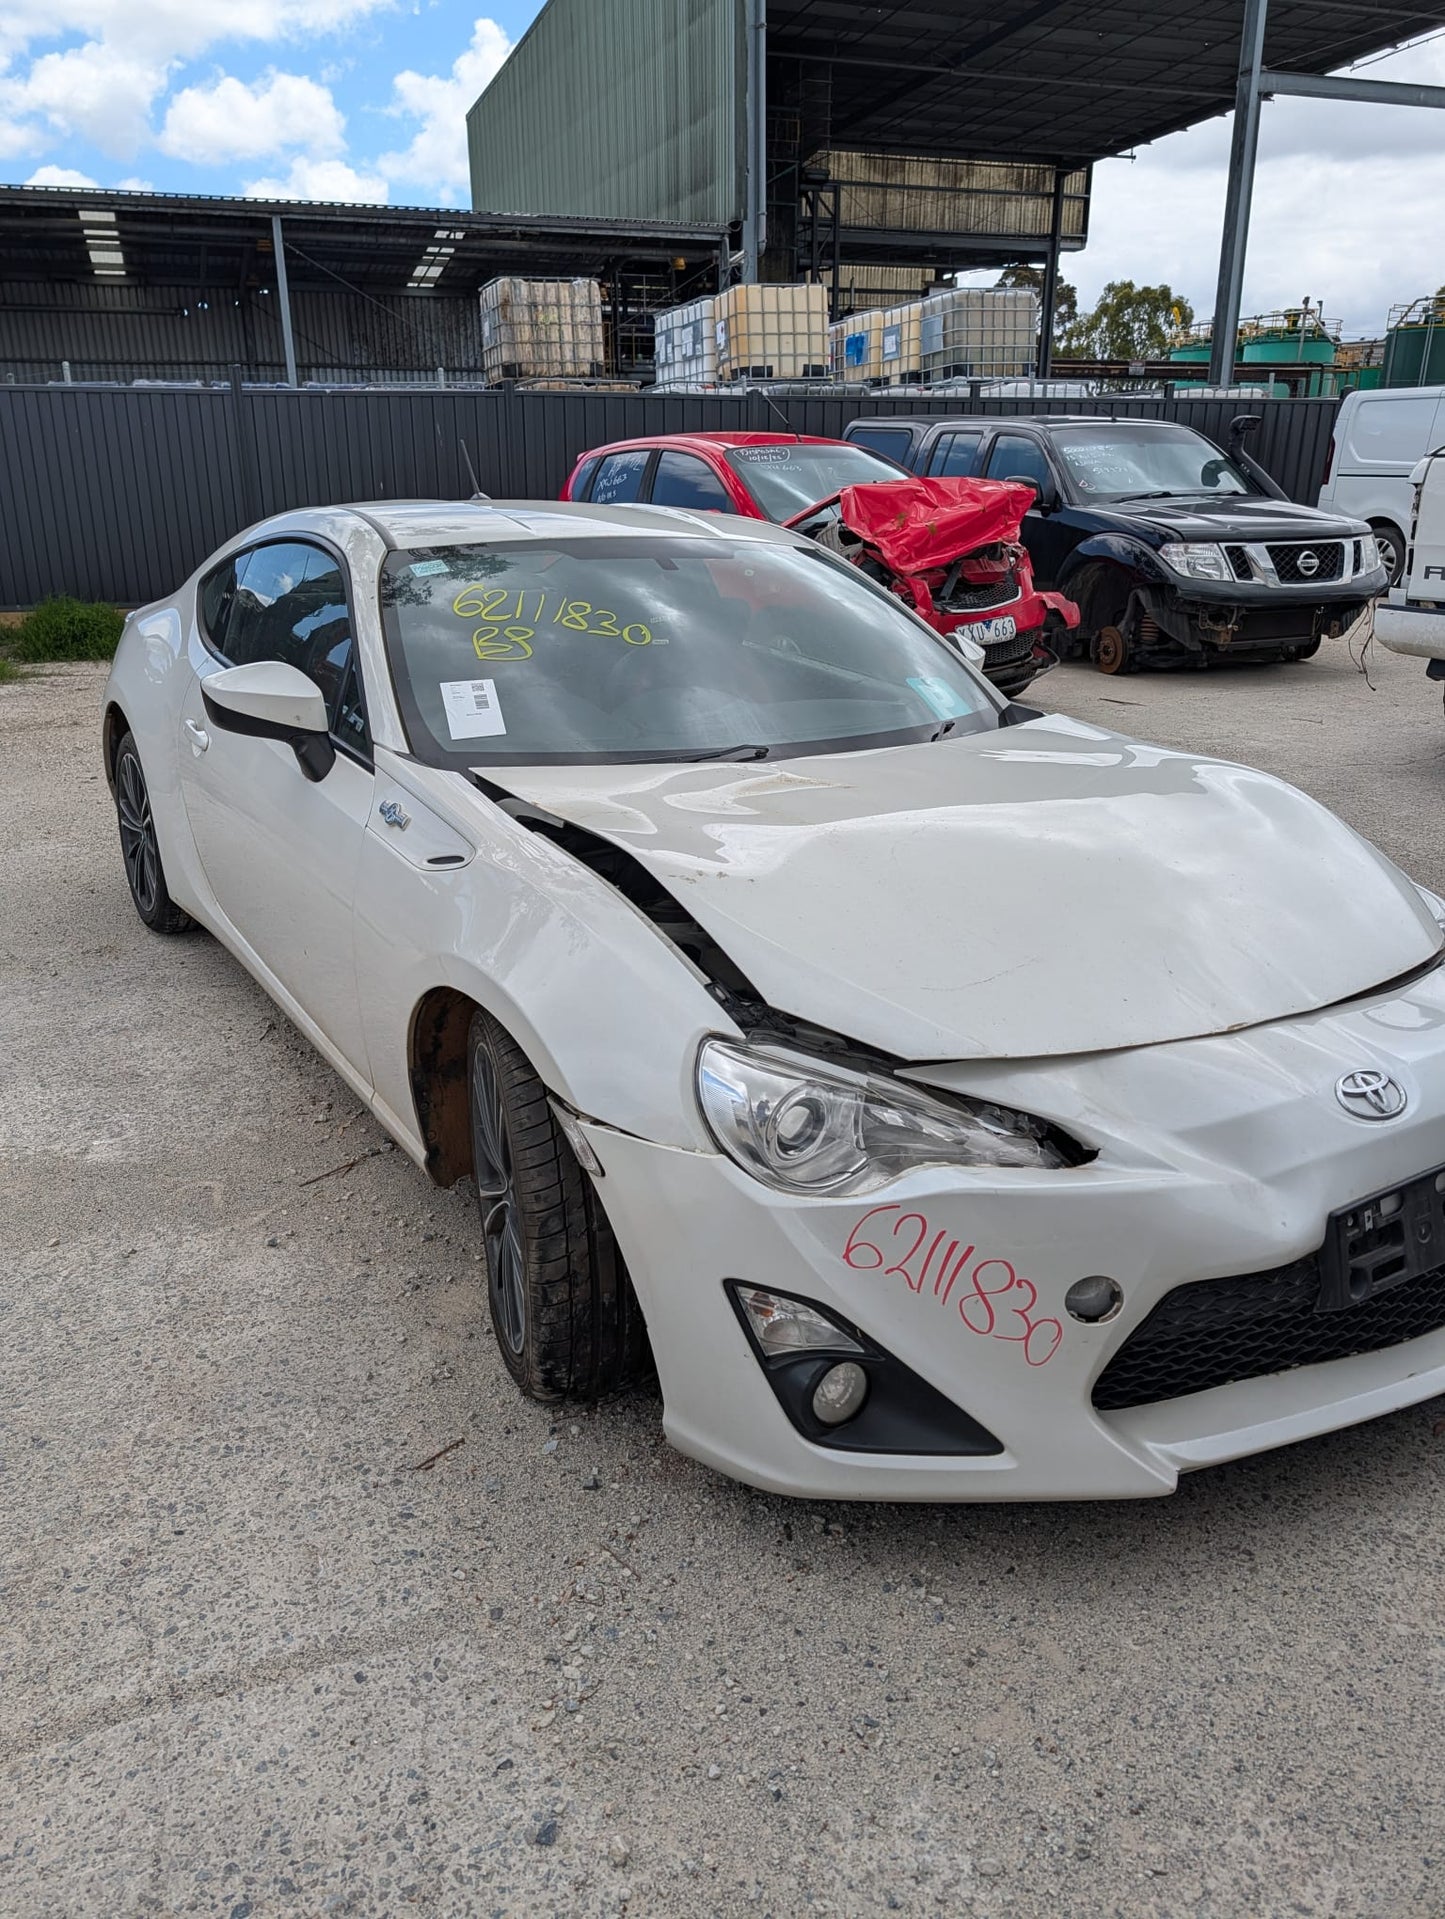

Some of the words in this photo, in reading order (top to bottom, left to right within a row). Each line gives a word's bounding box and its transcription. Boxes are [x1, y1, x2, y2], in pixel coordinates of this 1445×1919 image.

[453, 583, 652, 646] 6211830
[994, 619, 1015, 638] 663
[842, 1204, 1063, 1367] 6211830
